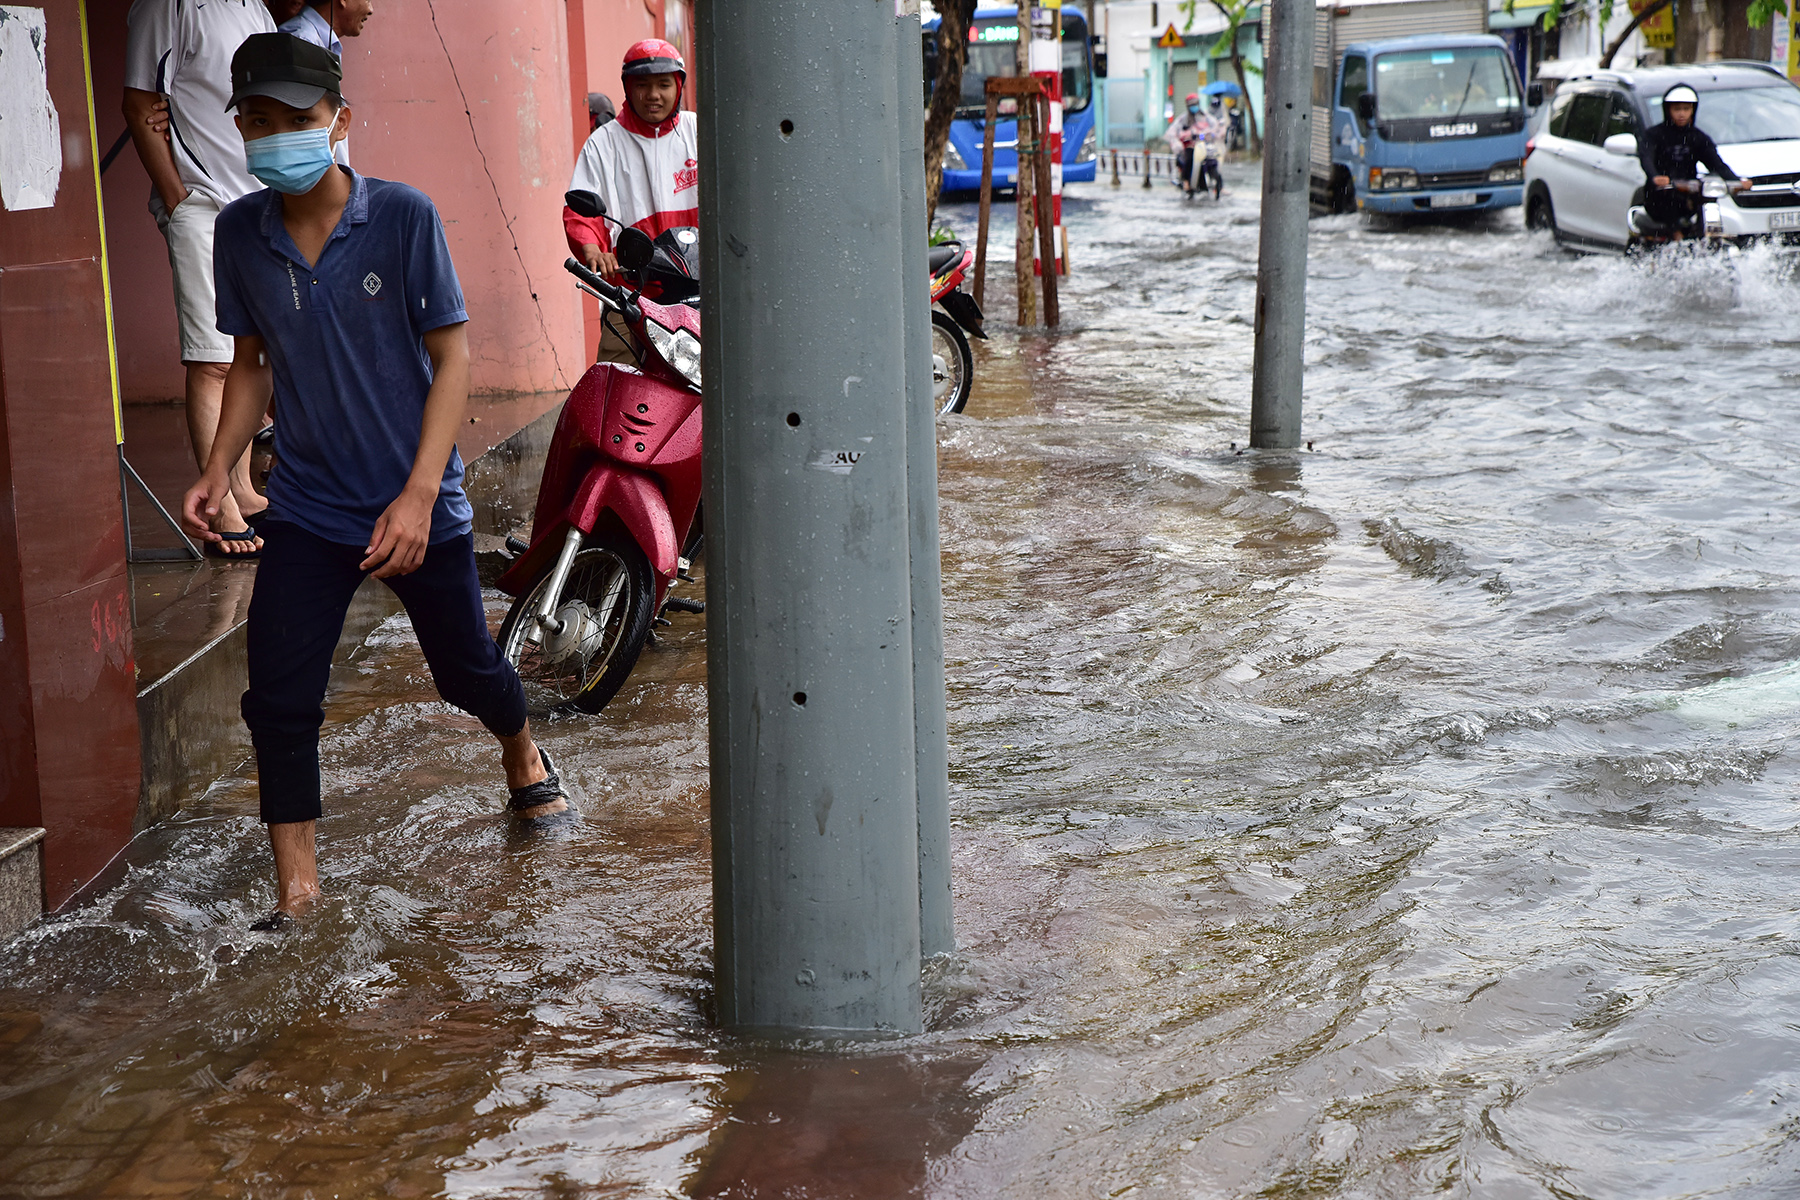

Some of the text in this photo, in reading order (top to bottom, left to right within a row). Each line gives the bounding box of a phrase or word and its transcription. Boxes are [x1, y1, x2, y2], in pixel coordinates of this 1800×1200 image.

[1430, 122, 1478, 137] ISUZU
[288, 268, 298, 288] NAME
[292, 288, 301, 310] JEANS
